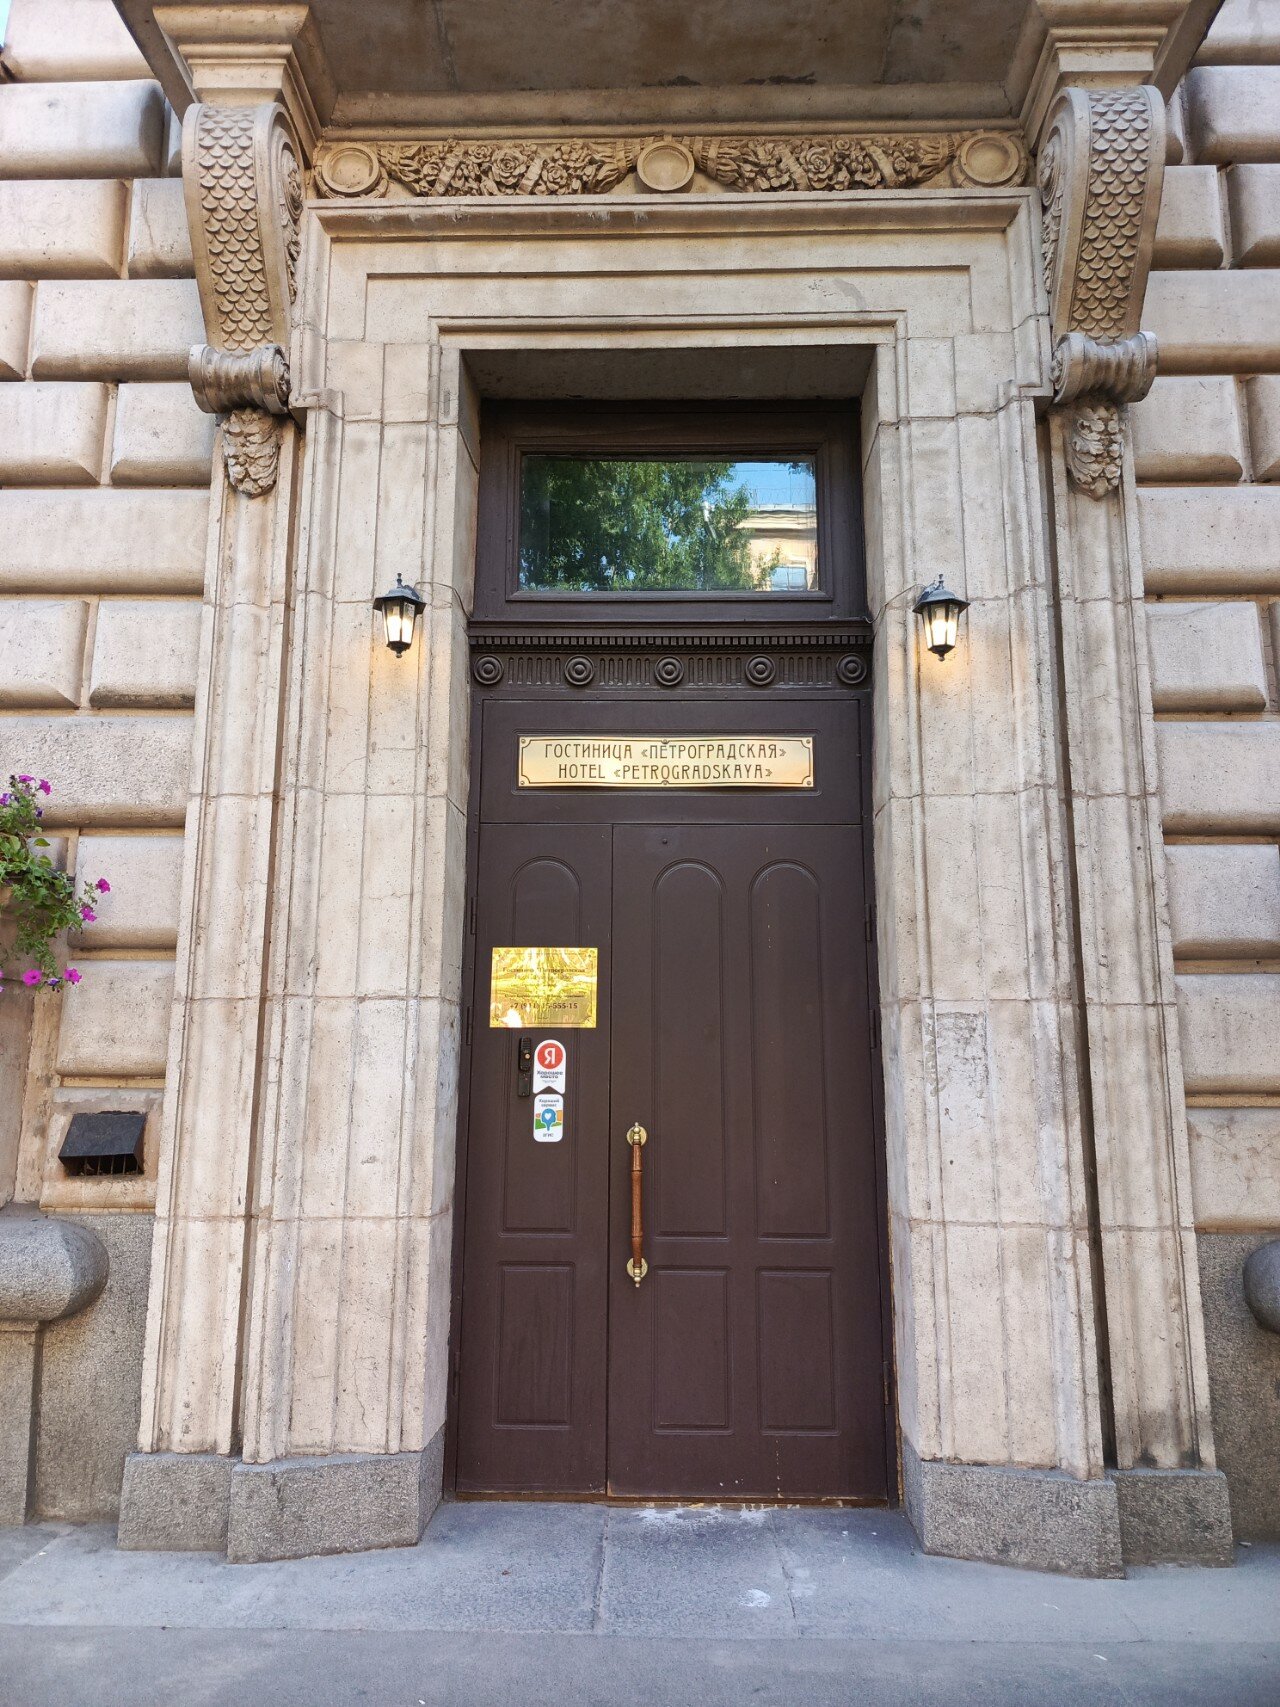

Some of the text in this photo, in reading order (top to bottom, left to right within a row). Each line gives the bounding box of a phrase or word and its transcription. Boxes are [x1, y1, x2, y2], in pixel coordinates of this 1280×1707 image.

[544, 743, 787, 761] ГОСТИНИЦА «ПЕТРОГРАДСКАЯ»
[558, 763, 773, 780] HOTEL «PETROGRADSKAYA»
[544, 1047, 556, 1065] Я
